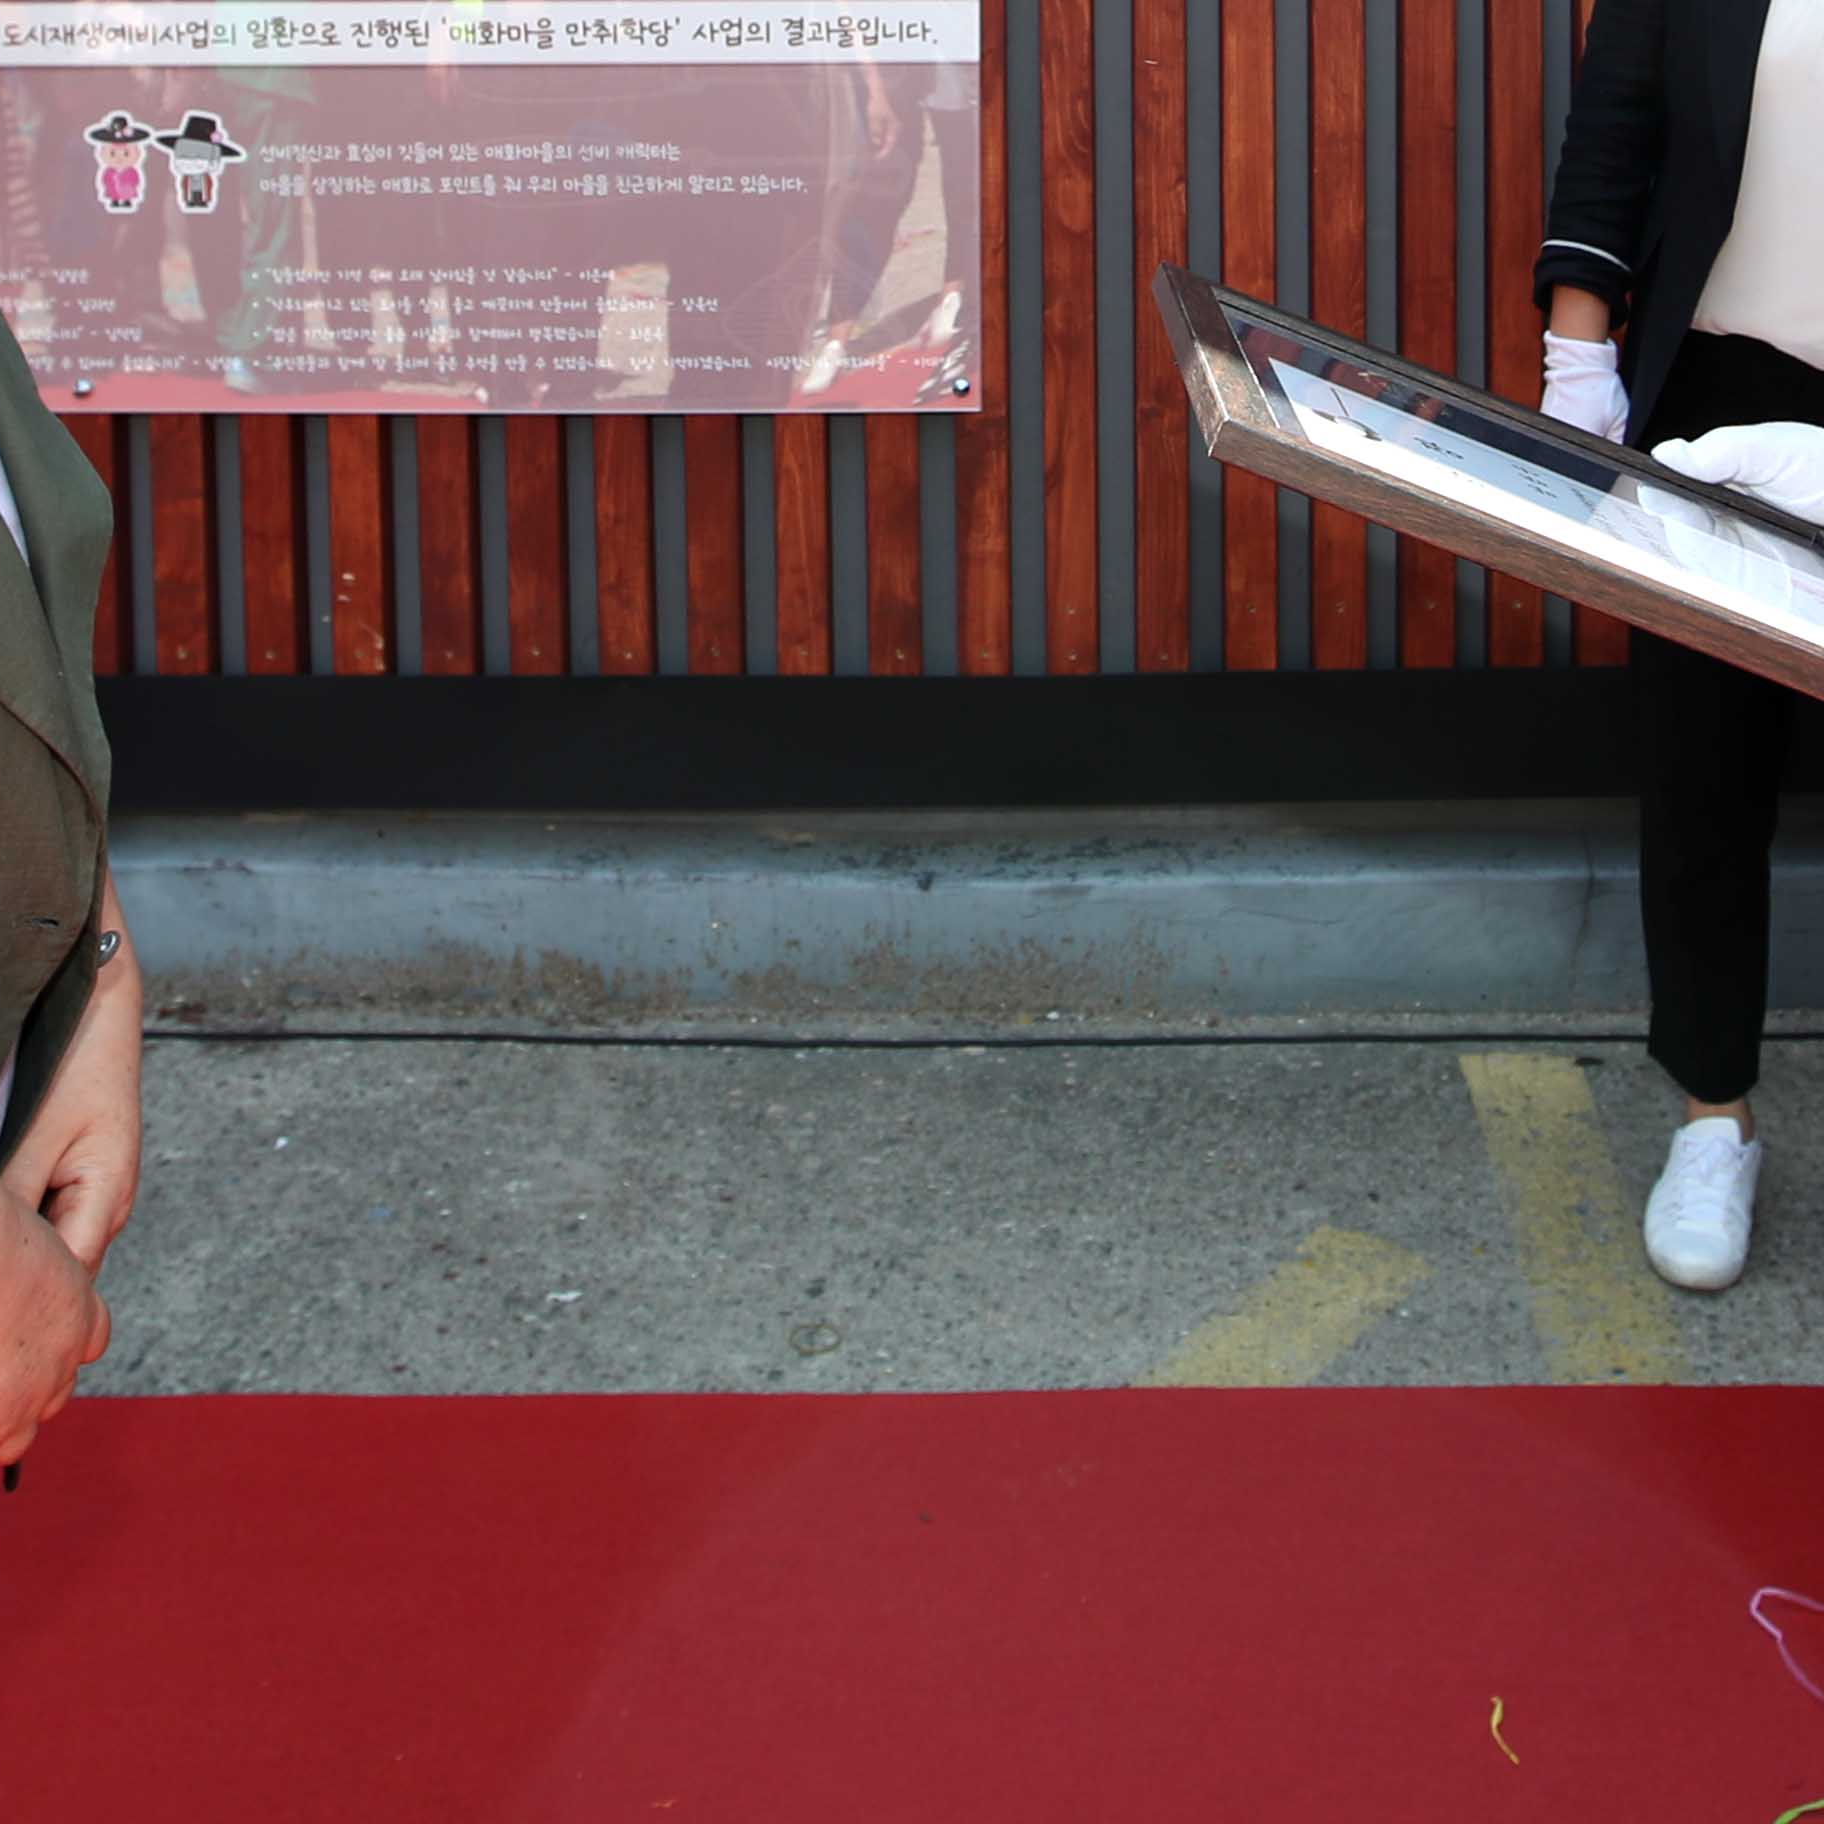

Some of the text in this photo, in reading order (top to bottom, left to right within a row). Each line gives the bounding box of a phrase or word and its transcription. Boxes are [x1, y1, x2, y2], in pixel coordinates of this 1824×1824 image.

[1, 18, 236, 49] 도시재생예비사업의
[247, 17, 342, 49] 일환으로
[351, 18, 430, 49] 진행된
[691, 17, 771, 48] 사업의
[780, 15, 940, 49] 결과물입니다.
